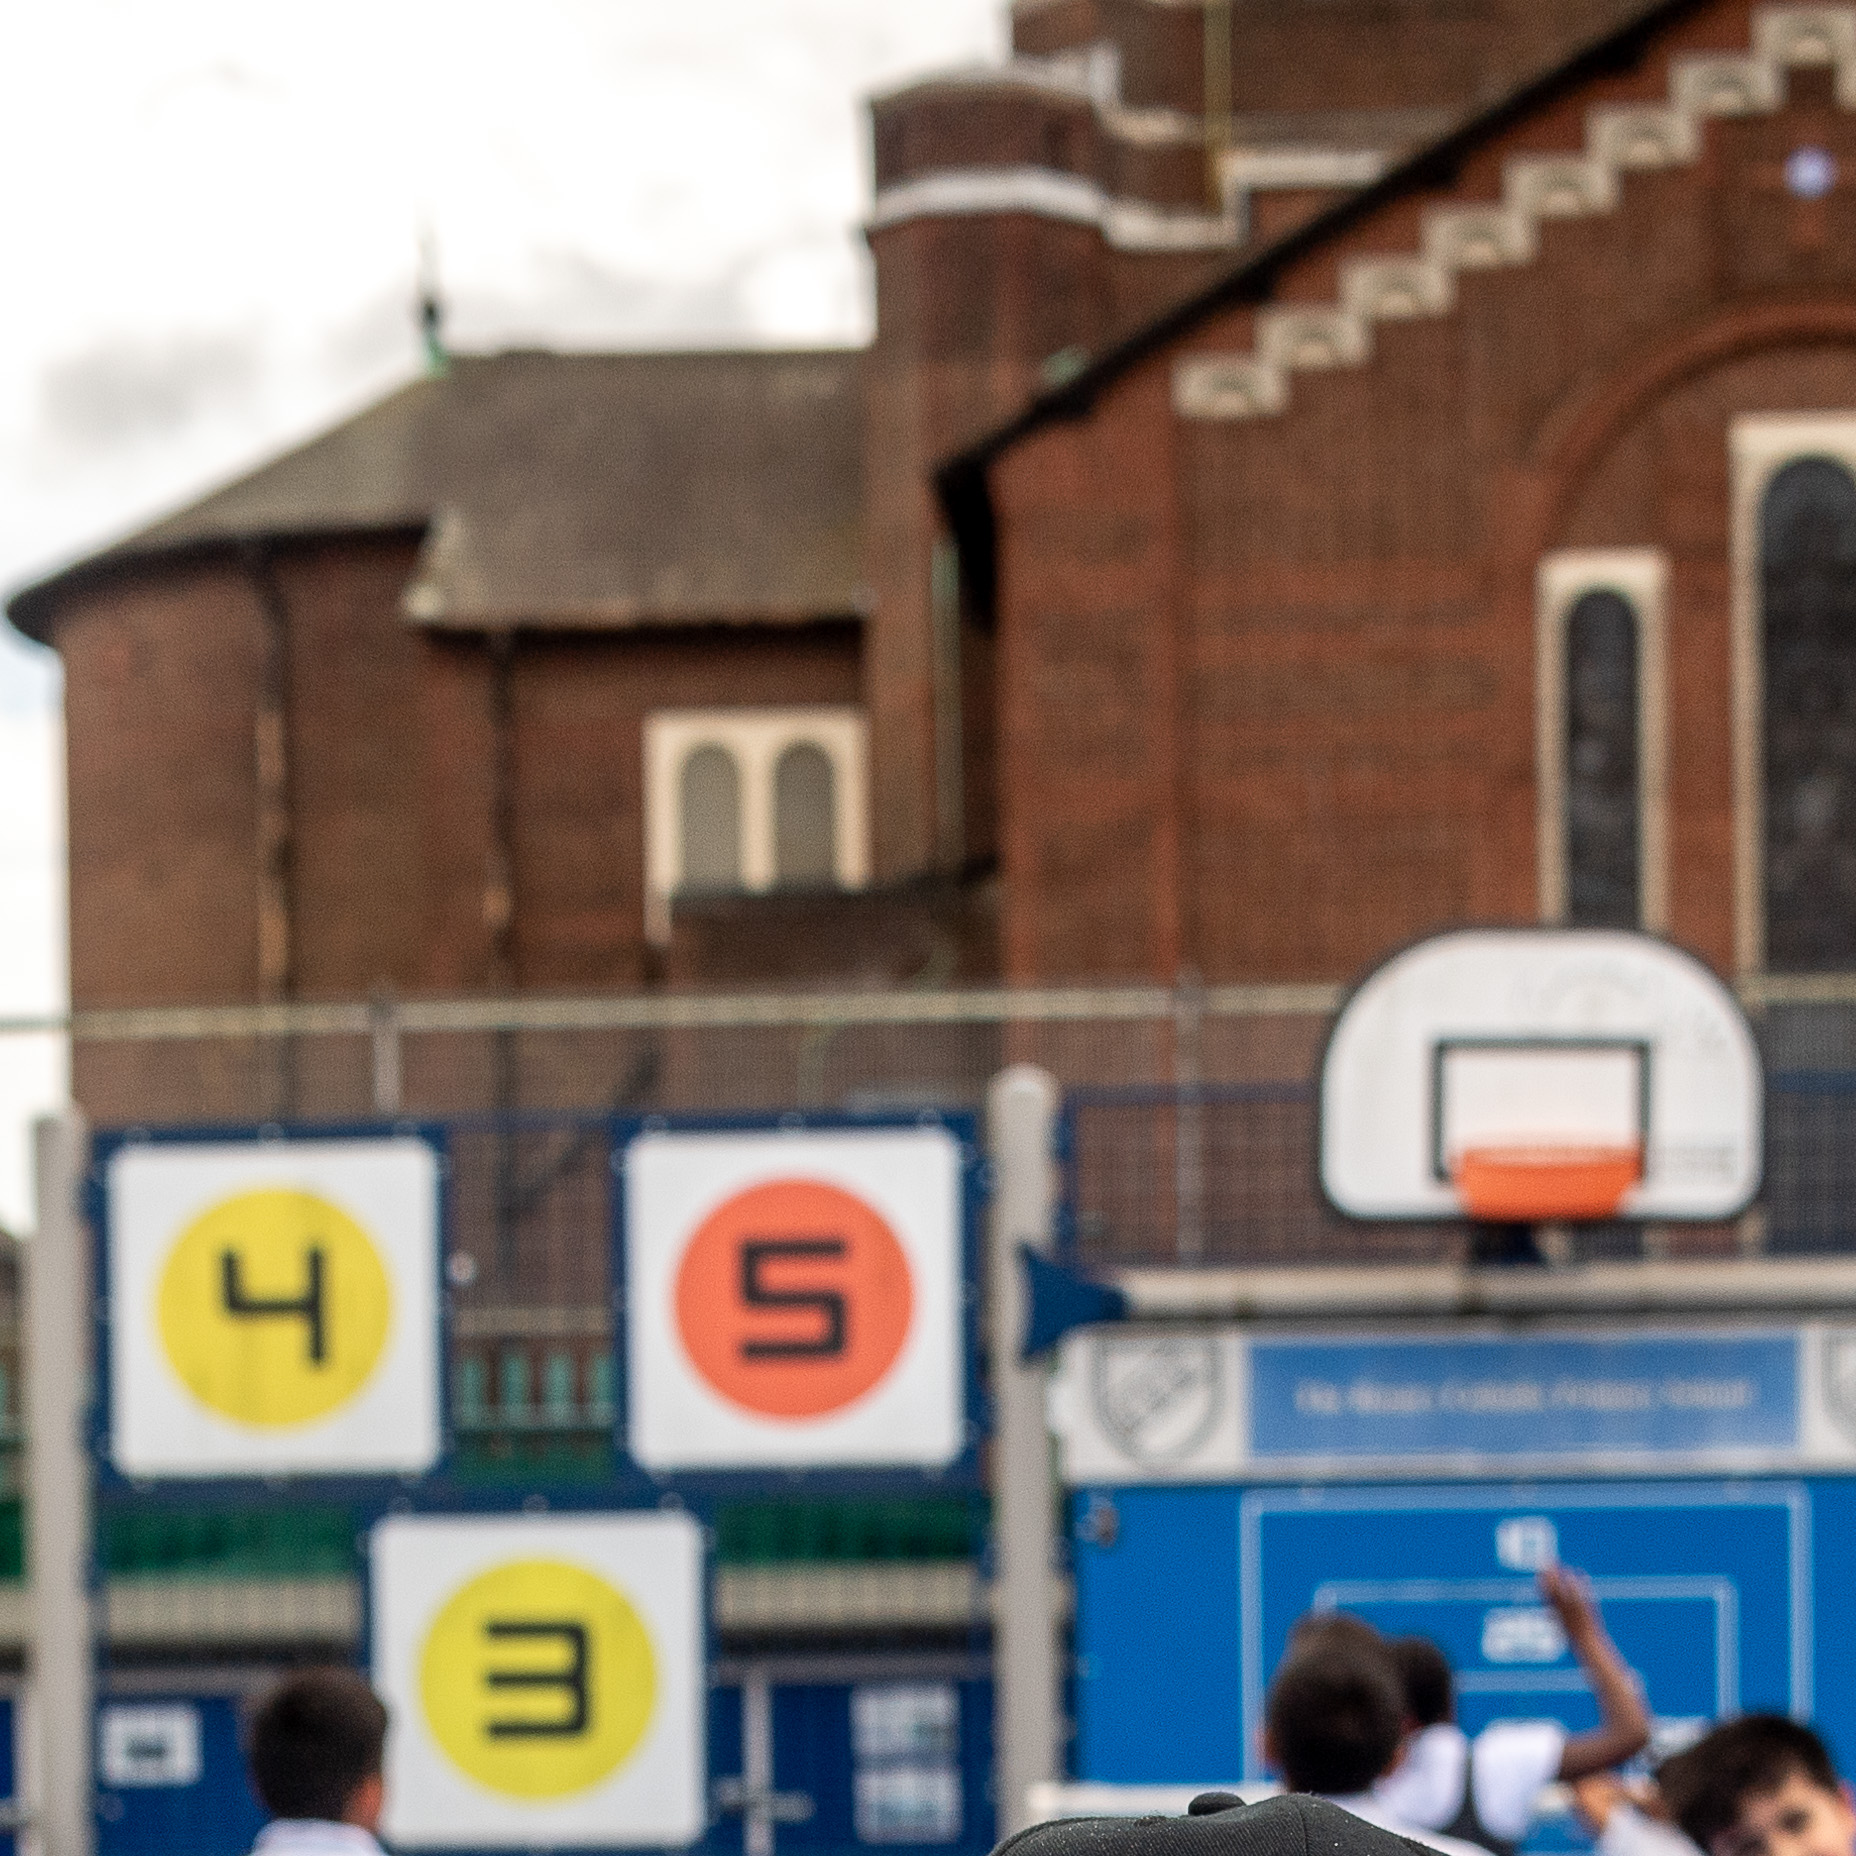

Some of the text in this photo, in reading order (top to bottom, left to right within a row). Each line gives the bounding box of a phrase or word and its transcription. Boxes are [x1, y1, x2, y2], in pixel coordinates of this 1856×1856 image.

[218, 1236, 328, 1368] 4
[734, 1236, 849, 1361] 5
[480, 1618, 594, 1742] 3
